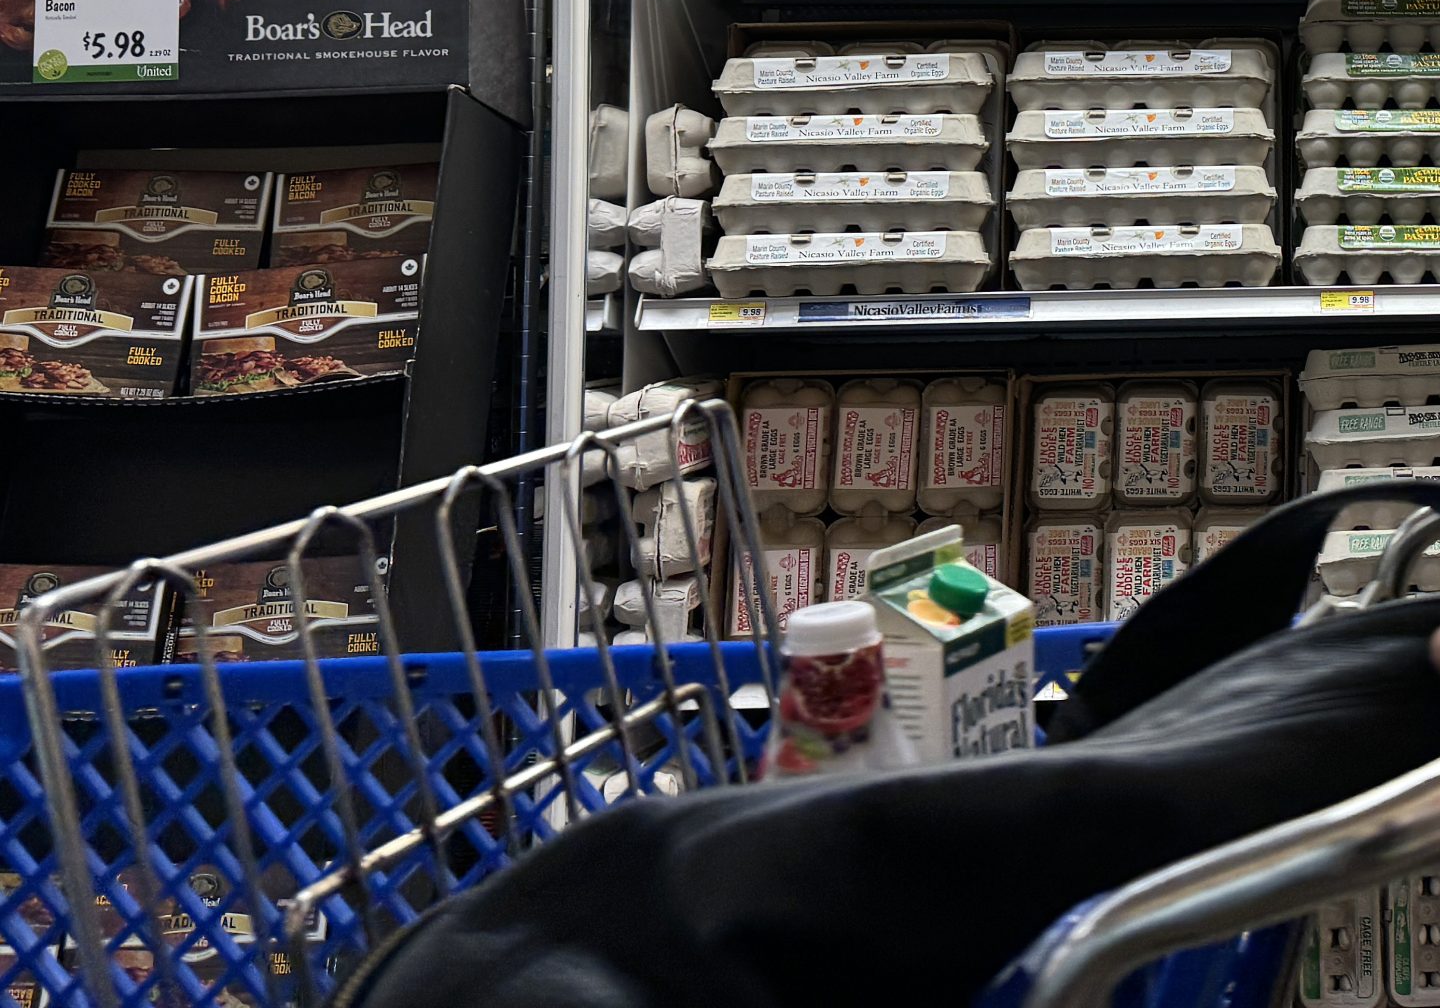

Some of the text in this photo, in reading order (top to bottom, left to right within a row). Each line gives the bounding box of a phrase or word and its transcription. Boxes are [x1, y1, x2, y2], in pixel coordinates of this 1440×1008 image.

[45, 0, 75, 11] Bacon
[245, 10, 432, 41] Boar's Head
[83, 31, 145, 59] $5.98
[228, 53, 310, 61] TRADITIONAL
[316, 50, 398, 58] SMOKEHOUSE
[917, 62, 938, 70] Certified
[137, 66, 172, 77] United
[760, 69, 793, 78] Marin County
[910, 68, 944, 78] Organic Eggs
[758, 76, 795, 85] Pasture Raised
[806, 72, 899, 82] Nicasio Valley Farm
[1095, 125, 1128, 134] Nicasio
[1132, 125, 1159, 134] Valley
[67, 180, 100, 188] COOKED
[290, 176, 315, 184] FULLY
[289, 183, 321, 191] COOKED
[288, 192, 315, 200] BACON
[124, 208, 189, 219] TRADITIONAL
[350, 203, 413, 215] TRADITIONAL
[213, 247, 245, 255] COOKED
[211, 276, 238, 285] FULLY
[210, 284, 246, 294] COOKED
[210, 294, 238, 303] BACON
[34, 311, 103, 323] TRADITIONAL
[275, 305, 347, 319] TRADITIONAL
[378, 329, 405, 339] FULLY
[378, 338, 413, 348] COOKED
[129, 347, 156, 356] FULLY
[127, 356, 162, 366] COOKED
[950, 418, 956, 428] AA
[956, 427, 965, 467] LARGE EGGS
[1116, 558, 1126, 596] UNCLE
[1125, 557, 1133, 596] EDDIE'S
[1134, 557, 1143, 595] WILD HEN
[1143, 557, 1152, 596] FARM
[1363, 917, 1371, 977] CAGE FREE
